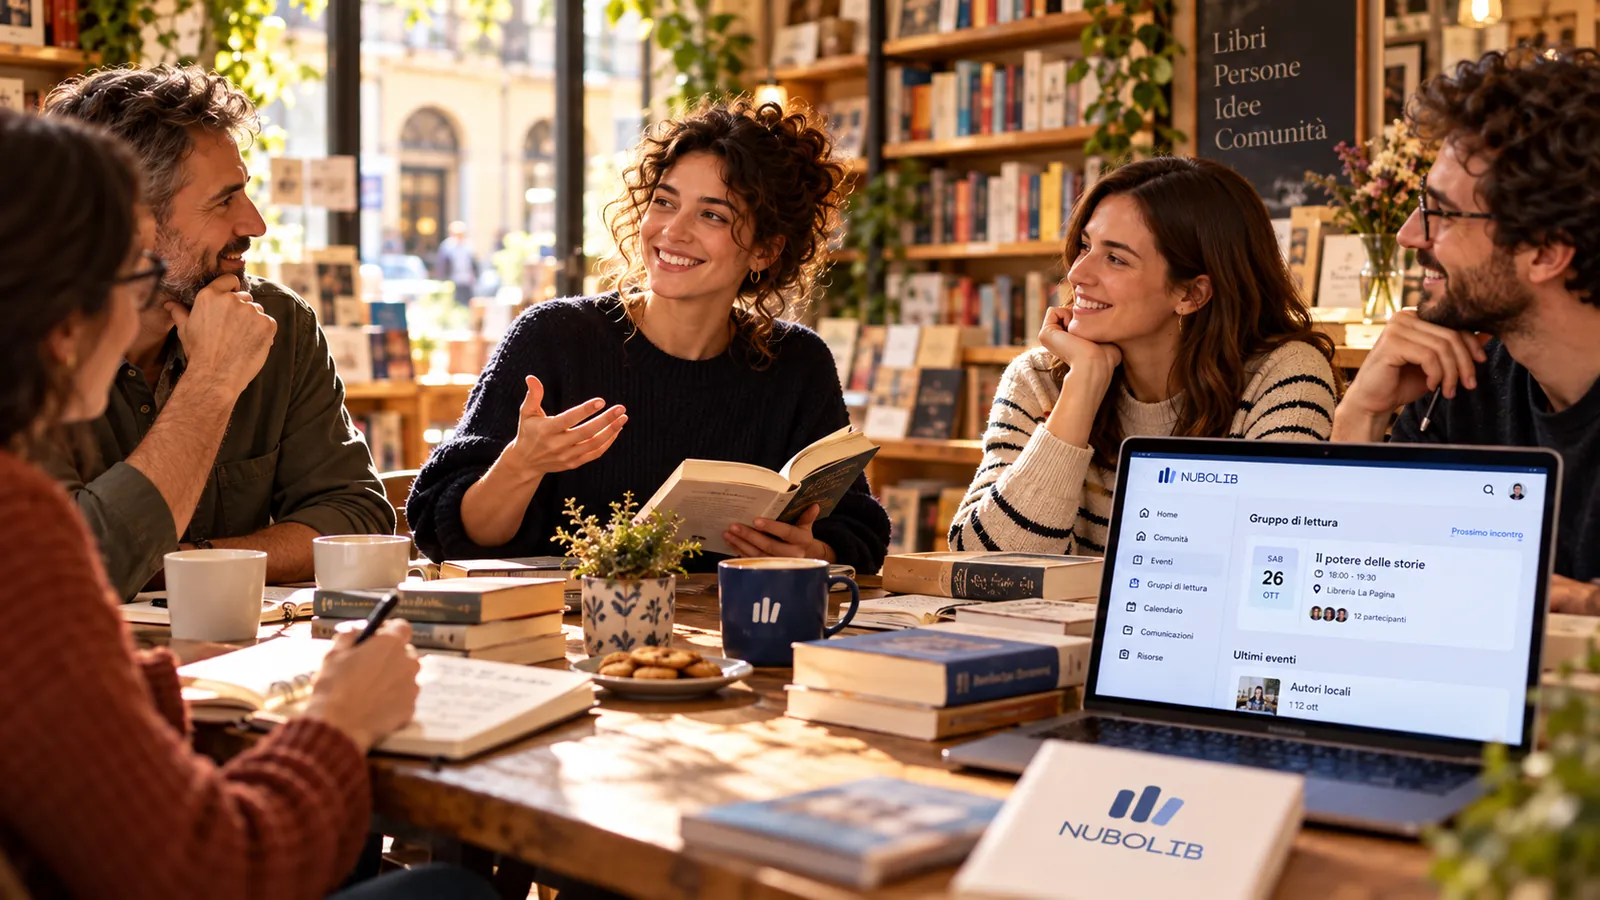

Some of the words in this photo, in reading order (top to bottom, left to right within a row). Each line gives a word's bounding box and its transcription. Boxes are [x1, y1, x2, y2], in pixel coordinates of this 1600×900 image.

[1213, 26, 1267, 54] Libri
[1214, 60, 1301, 87] Persone
[1215, 95, 1261, 120] Idee
[1215, 117, 1328, 151] Comunità
[1181, 472, 1239, 484] NUBOLIB
[1157, 510, 1178, 519] Home
[1249, 513, 1289, 526] Gruppo
[1291, 516, 1301, 526] di
[1304, 516, 1339, 528] lettura
[1153, 534, 1189, 543] Comunità
[1451, 527, 1488, 537] Prossimo
[1489, 529, 1524, 539] incontro
[1150, 557, 1173, 566] Eventi
[1267, 555, 1284, 563] SAB
[1325, 554, 1361, 566] potere
[1364, 556, 1391, 567] delle
[1394, 558, 1426, 569] storie
[1262, 570, 1284, 586] 26
[1329, 571, 1349, 580] 18:00
[1357, 573, 1377, 582] 19:30
[1147, 581, 1173, 591] Gruppi
[1174, 582, 1182, 590] di
[1183, 583, 1208, 592] lettura
[1263, 591, 1280, 600] OTT
[1326, 586, 1356, 596] Libreria
[1358, 588, 1367, 597] La
[1369, 590, 1395, 600] Pagina
[1143, 604, 1183, 615] Calendario
[1354, 612, 1362, 620] 12
[1363, 614, 1407, 624] partecipanti
[1140, 628, 1194, 640] Comunicazioni
[1137, 652, 1164, 662] Risorse
[1233, 650, 1263, 662] Ultimi
[1265, 654, 1297, 665] eventi
[1290, 682, 1322, 694] Autori
[1324, 685, 1351, 697] locali
[1306, 703, 1319, 711] ott
[1058, 820, 1204, 861] NUBOLIB
